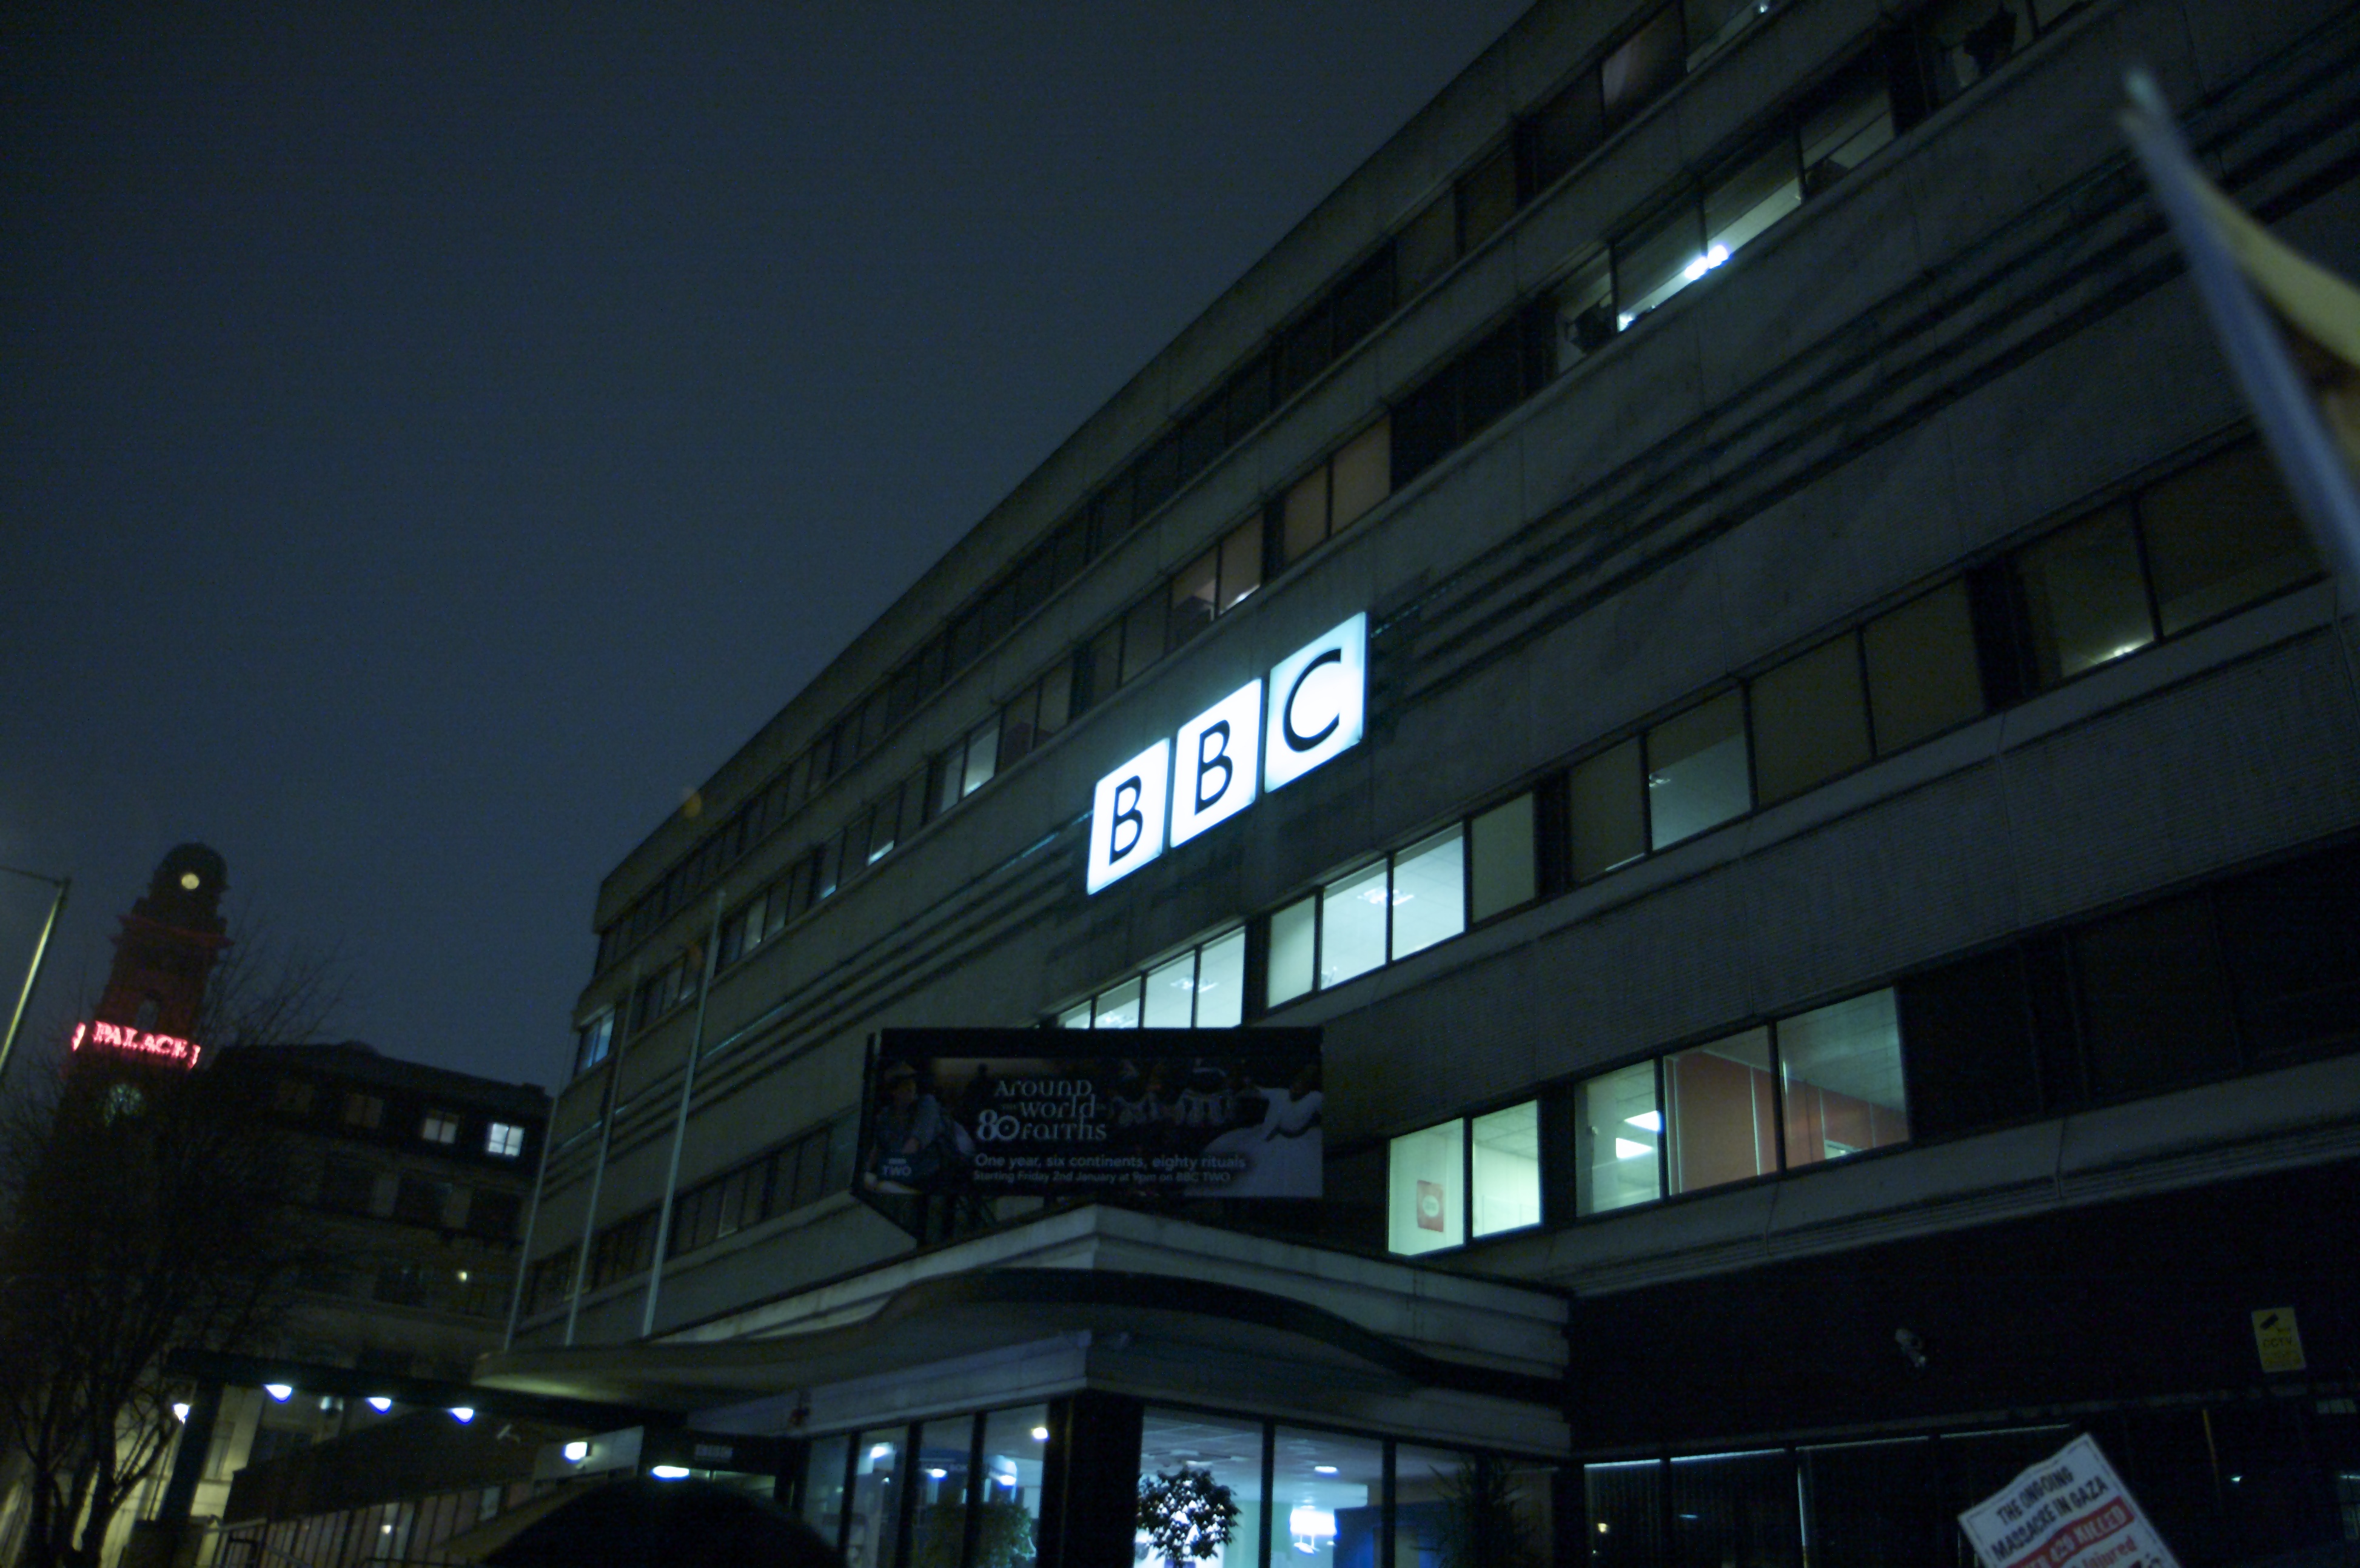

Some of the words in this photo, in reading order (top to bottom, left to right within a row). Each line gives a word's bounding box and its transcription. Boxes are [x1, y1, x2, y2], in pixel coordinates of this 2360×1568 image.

[1108, 648, 1342, 866] BBC
[92, 1020, 187, 1059] PALACE
[1019, 1093, 1096, 1119] world
[976, 1108, 1021, 1142] 80
[882, 1164, 912, 1177] TWO
[973, 1170, 1014, 1184] Starting
[1017, 1171, 1050, 1184] Friday
[1053, 1170, 1073, 1181] 2nd
[1076, 1171, 1116, 1184] January
[974, 1153, 1005, 1167] One
[1008, 1156, 1041, 1170] year,
[1046, 1153, 1065, 1167] six
[1069, 1154, 1147, 1170] continents,
[1152, 1153, 1198, 1171] eighty
[1201, 1153, 1246, 1168] rituals
[1996, 1498, 2023, 1526] THE
[2019, 1466, 2074, 1509] ONGOING
[1991, 1504, 2058, 1561] MASSACRE
[2052, 1495, 2073, 1515] IN
[2069, 1475, 2109, 1508] GAZA
[2072, 1504, 2128, 1544] KILLED
